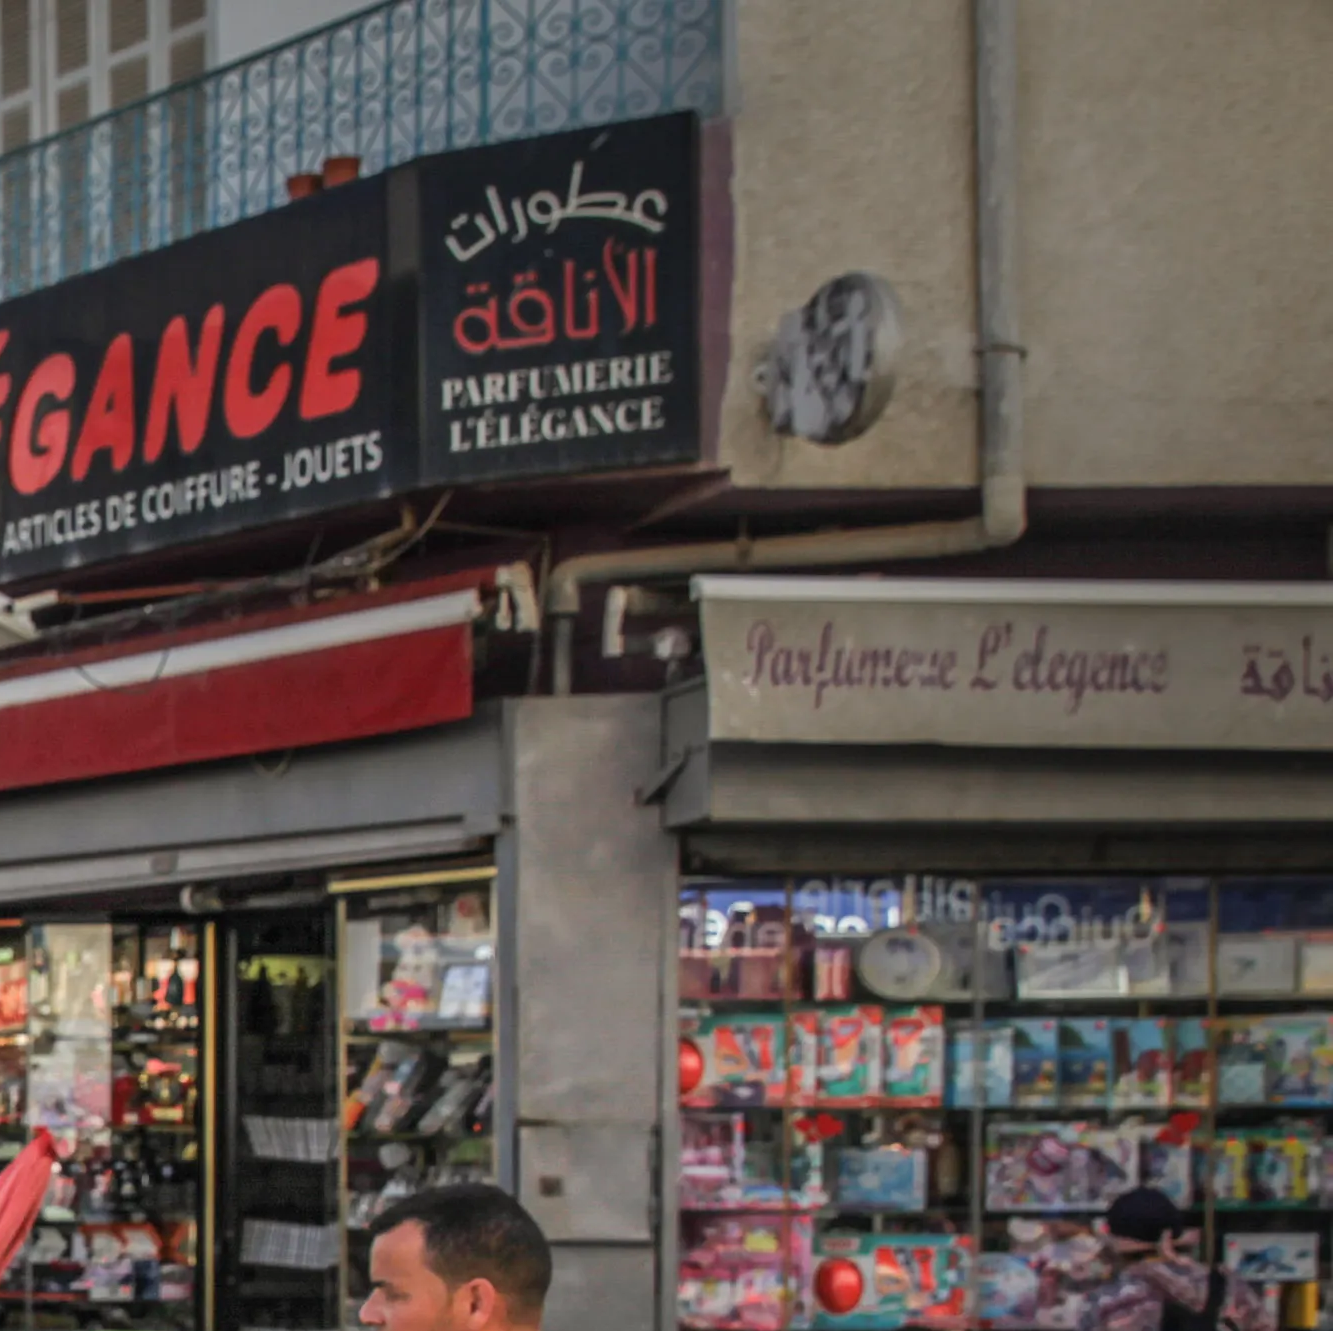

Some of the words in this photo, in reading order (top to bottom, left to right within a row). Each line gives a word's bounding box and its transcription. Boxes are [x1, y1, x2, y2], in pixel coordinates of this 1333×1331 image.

[444, 160, 669, 262] عطورات
[441, 351, 673, 411] PARFUMERIE
[449, 396, 665, 453] L'ÉLÉGANCE
[2, 500, 102, 556] ARTICLES
[105, 491, 138, 533] DE
[141, 461, 261, 523] COIFFURE
[280, 430, 384, 492] JOUETS
